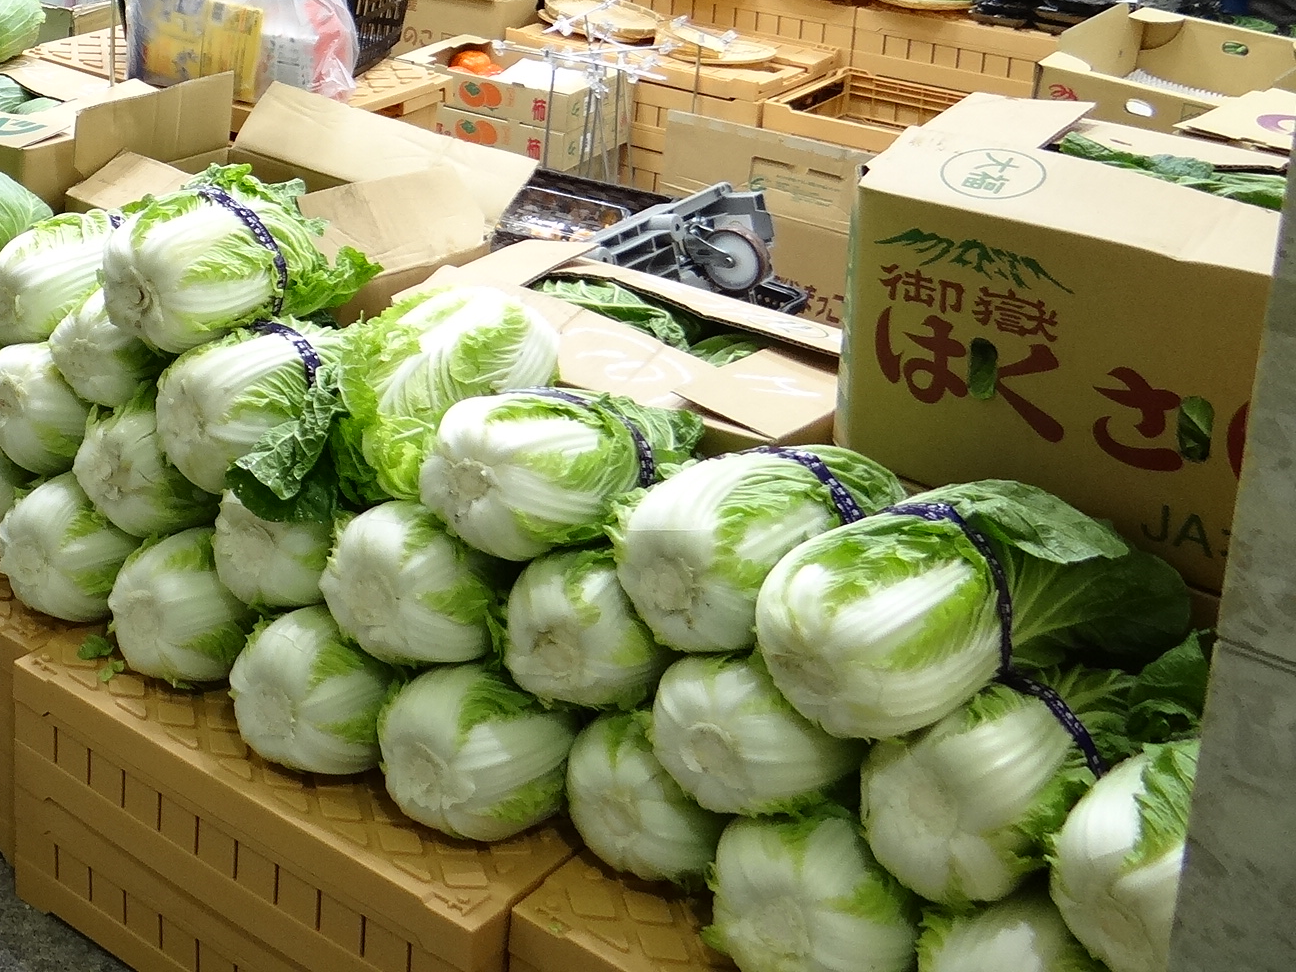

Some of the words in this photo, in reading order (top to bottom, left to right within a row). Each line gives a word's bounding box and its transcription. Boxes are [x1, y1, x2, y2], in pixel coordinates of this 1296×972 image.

[875, 305, 1250, 481] はくさ
[1140, 503, 1233, 559] JA
